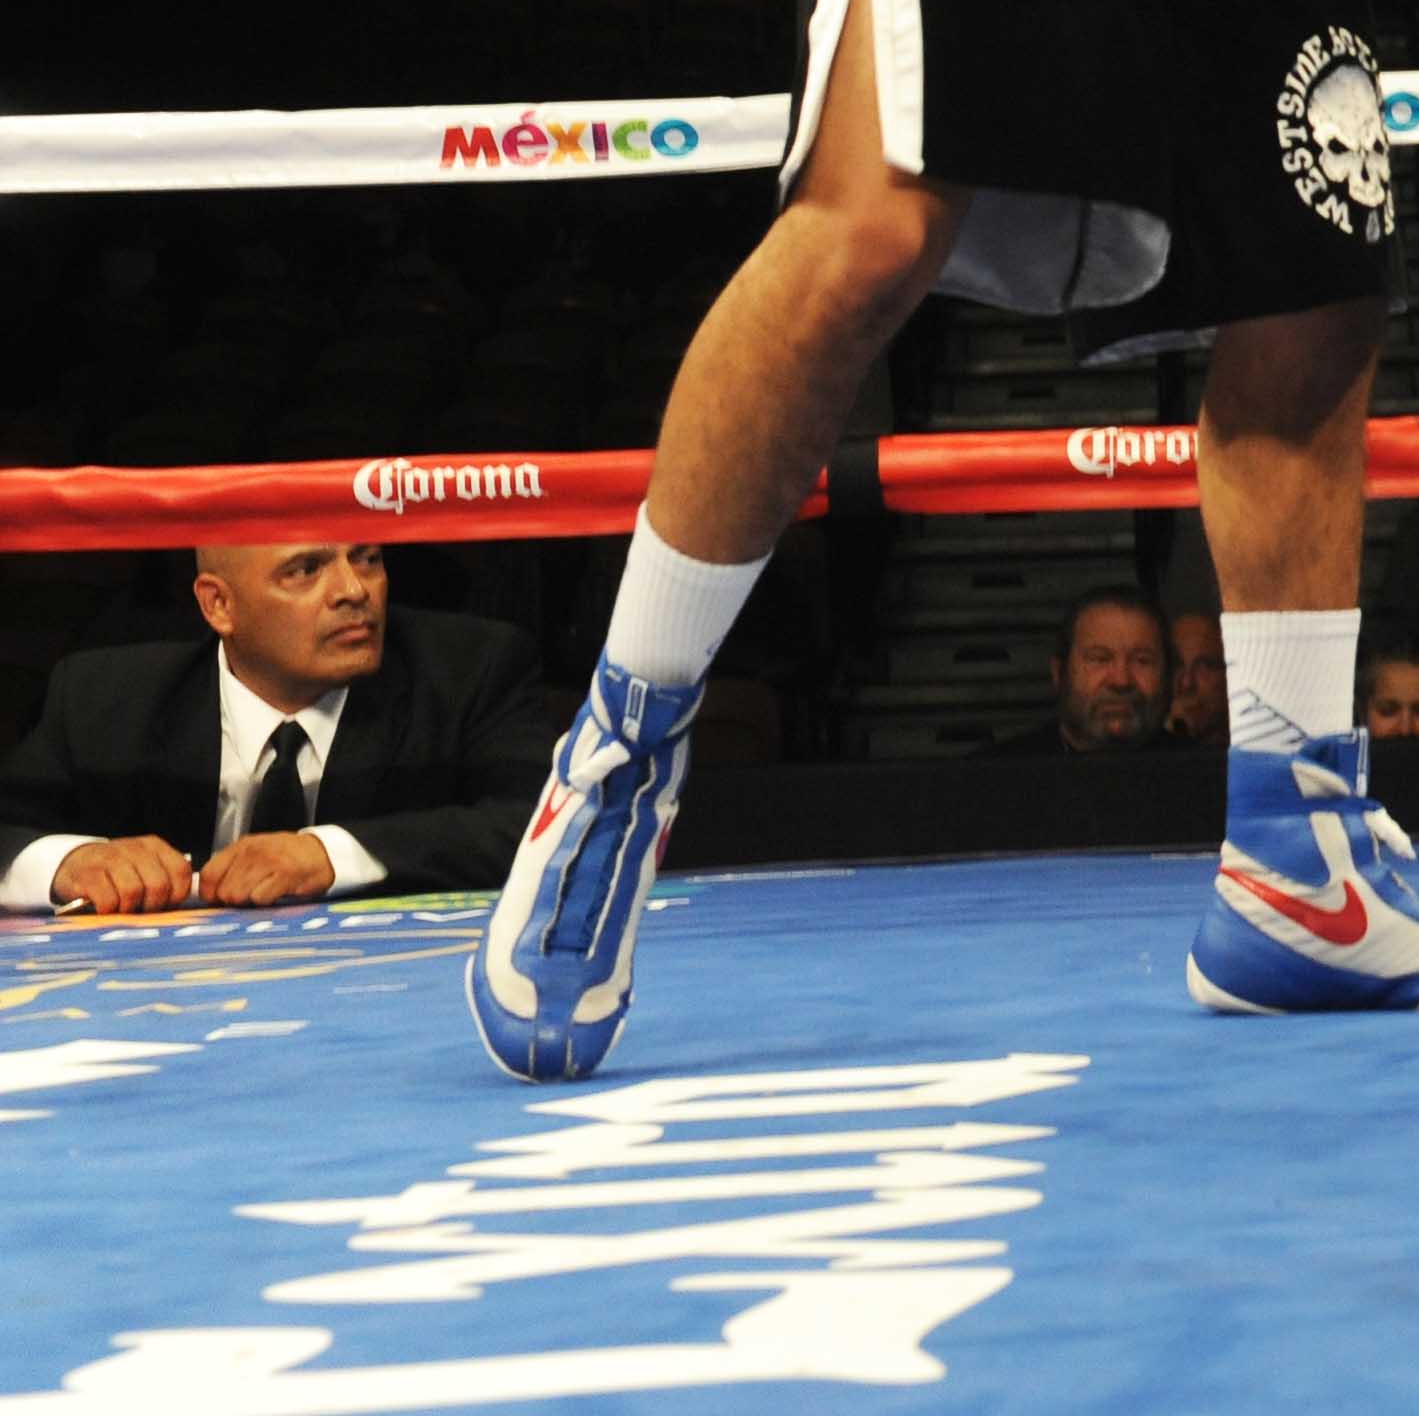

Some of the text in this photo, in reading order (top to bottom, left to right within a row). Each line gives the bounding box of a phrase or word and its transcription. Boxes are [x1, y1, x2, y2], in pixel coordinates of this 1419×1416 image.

[1277, 35, 1353, 235] WESTSIDE
[1066, 426, 1199, 478] Coro
[352, 457, 545, 515] Corona
